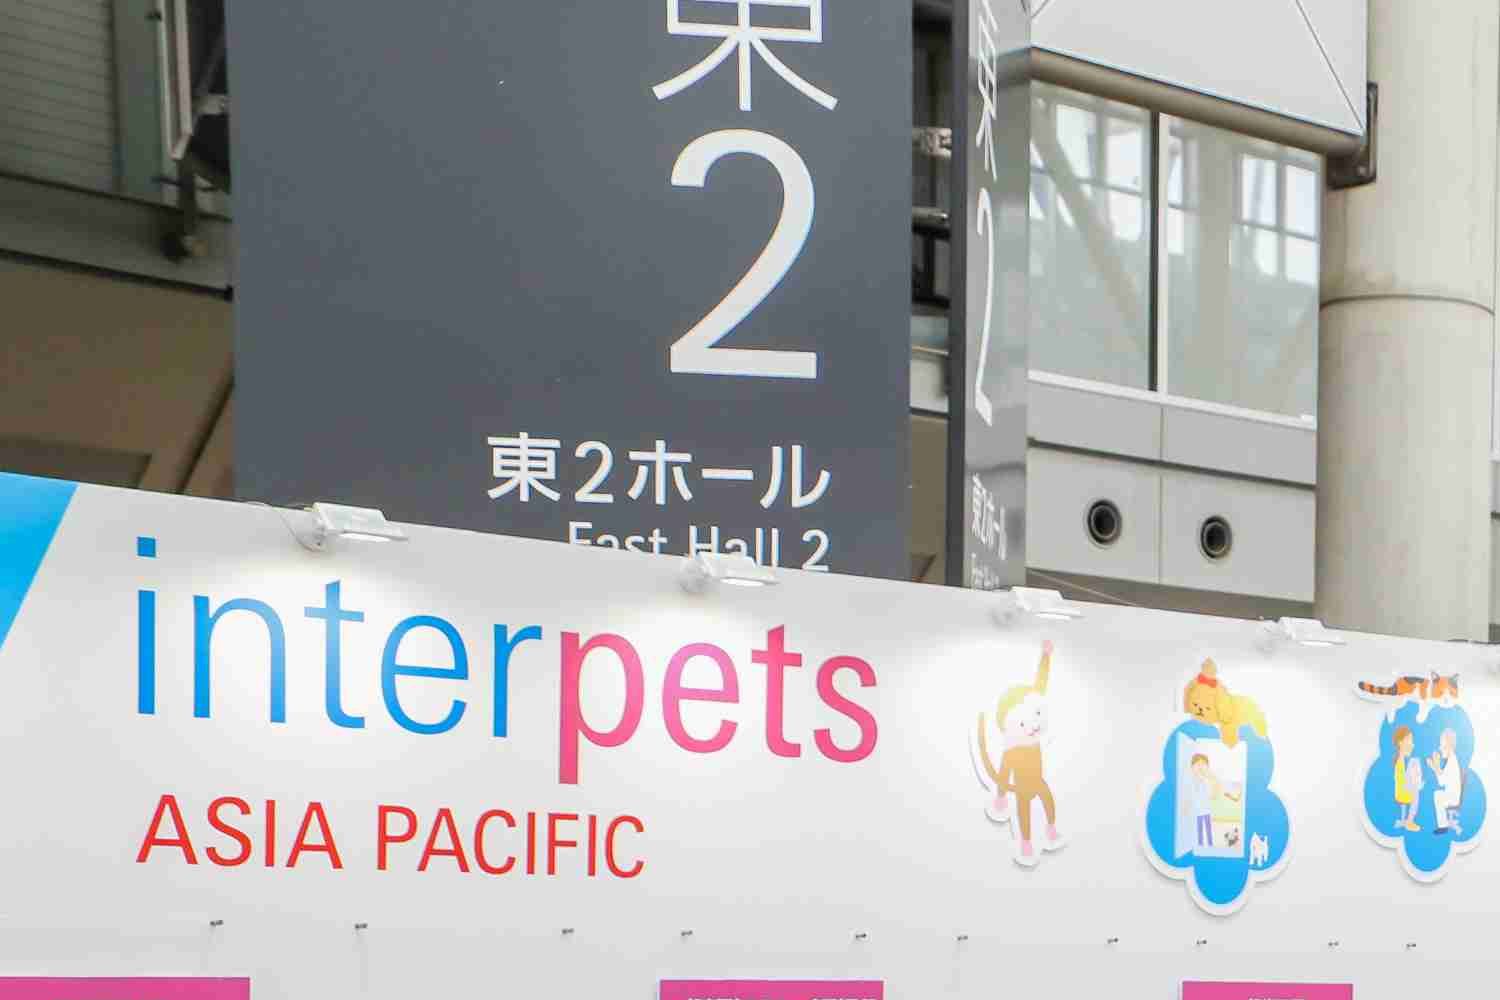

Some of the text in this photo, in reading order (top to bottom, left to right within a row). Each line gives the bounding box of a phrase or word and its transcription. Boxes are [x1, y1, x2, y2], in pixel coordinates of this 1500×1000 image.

[487, 431, 832, 509] 東2ホール
[801, 528, 831, 571] 2
[136, 536, 880, 786] interpets
[136, 793, 646, 879] ASIA PACIFIC
